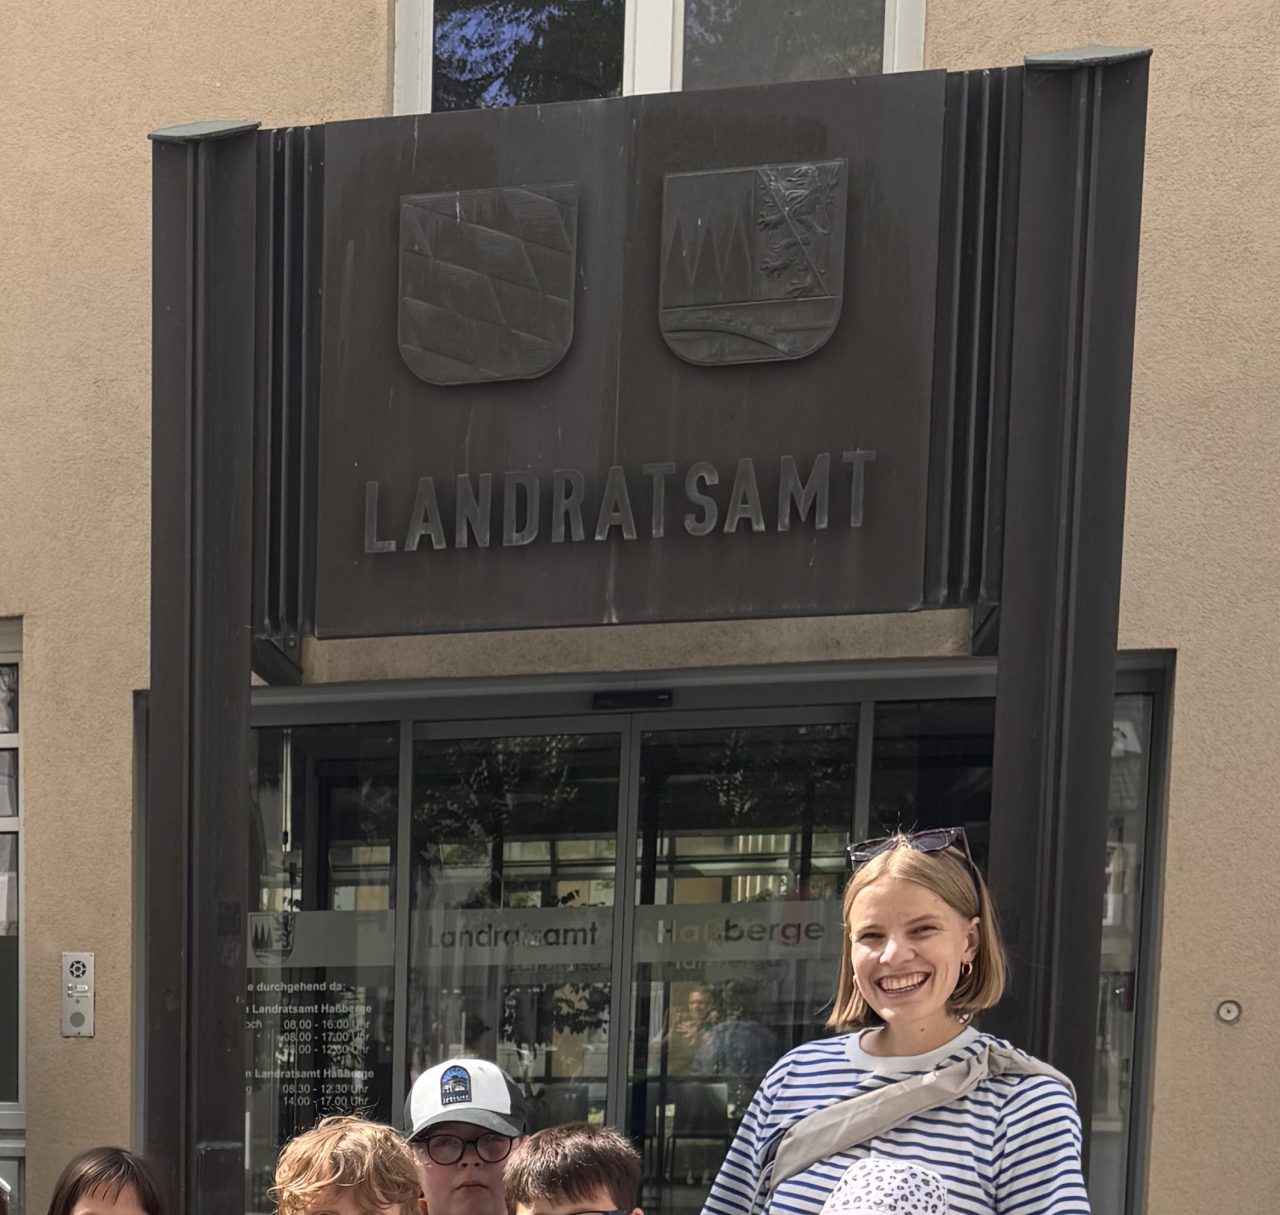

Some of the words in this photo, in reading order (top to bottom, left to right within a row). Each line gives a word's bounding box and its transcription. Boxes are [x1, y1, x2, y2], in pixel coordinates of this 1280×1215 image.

[364, 449, 877, 553] LANDRATSAMT
[428, 921, 598, 949] Landratsamt
[657, 917, 825, 946] Haßberge
[257, 981, 326, 993] durchgehend
[329, 981, 346, 992] da:
[252, 1003, 319, 1014] Landratsamt
[321, 1003, 372, 1016] Haßberge
[283, 1019, 312, 1030] 08.00
[322, 1018, 349, 1030] 16.00
[352, 1018, 371, 1030] Uhr
[322, 1031, 349, 1042] 17.00
[255, 1069, 321, 1079] Landratsamt
[323, 1069, 375, 1081] Haßberge
[282, 1084, 311, 1094] 08.30
[321, 1083, 348, 1094] 12.30
[350, 1083, 369, 1094] Uhr
[283, 1096, 310, 1106] 14.00
[320, 1096, 348, 1107] 17.00
[350, 1096, 369, 1106] Uhr
